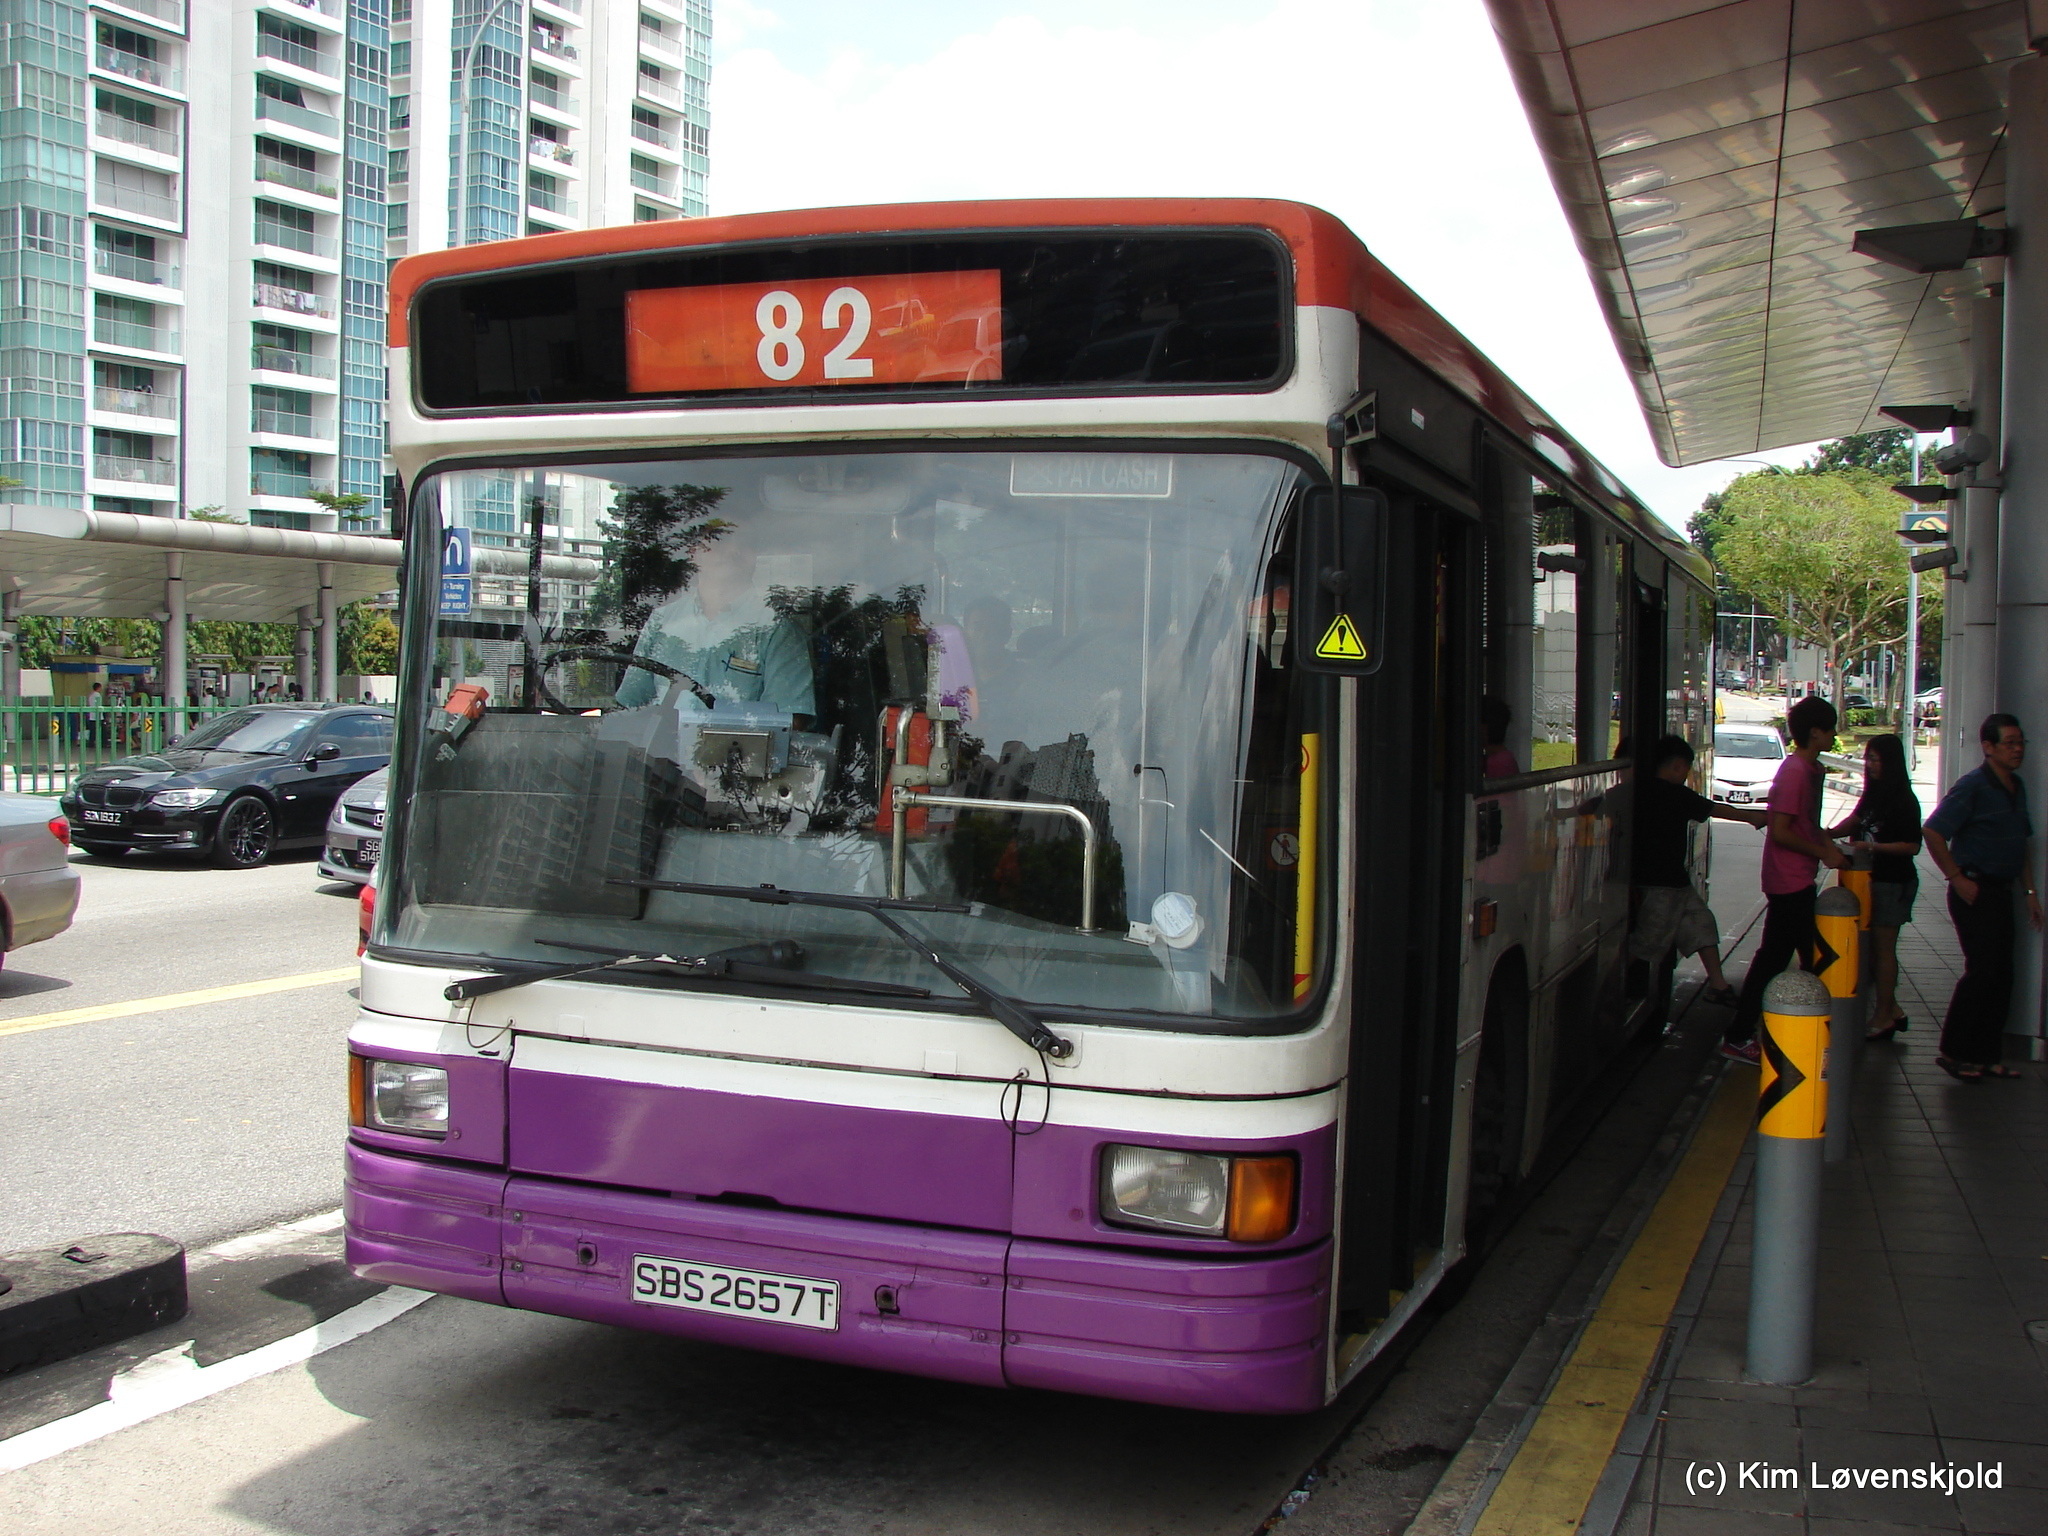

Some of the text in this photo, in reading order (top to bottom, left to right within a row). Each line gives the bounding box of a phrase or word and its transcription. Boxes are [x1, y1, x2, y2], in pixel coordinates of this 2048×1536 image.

[755, 286, 874, 382] 82
[1057, 457, 1158, 490] PAY CASH
[636, 1262, 834, 1321] SBS2657T
